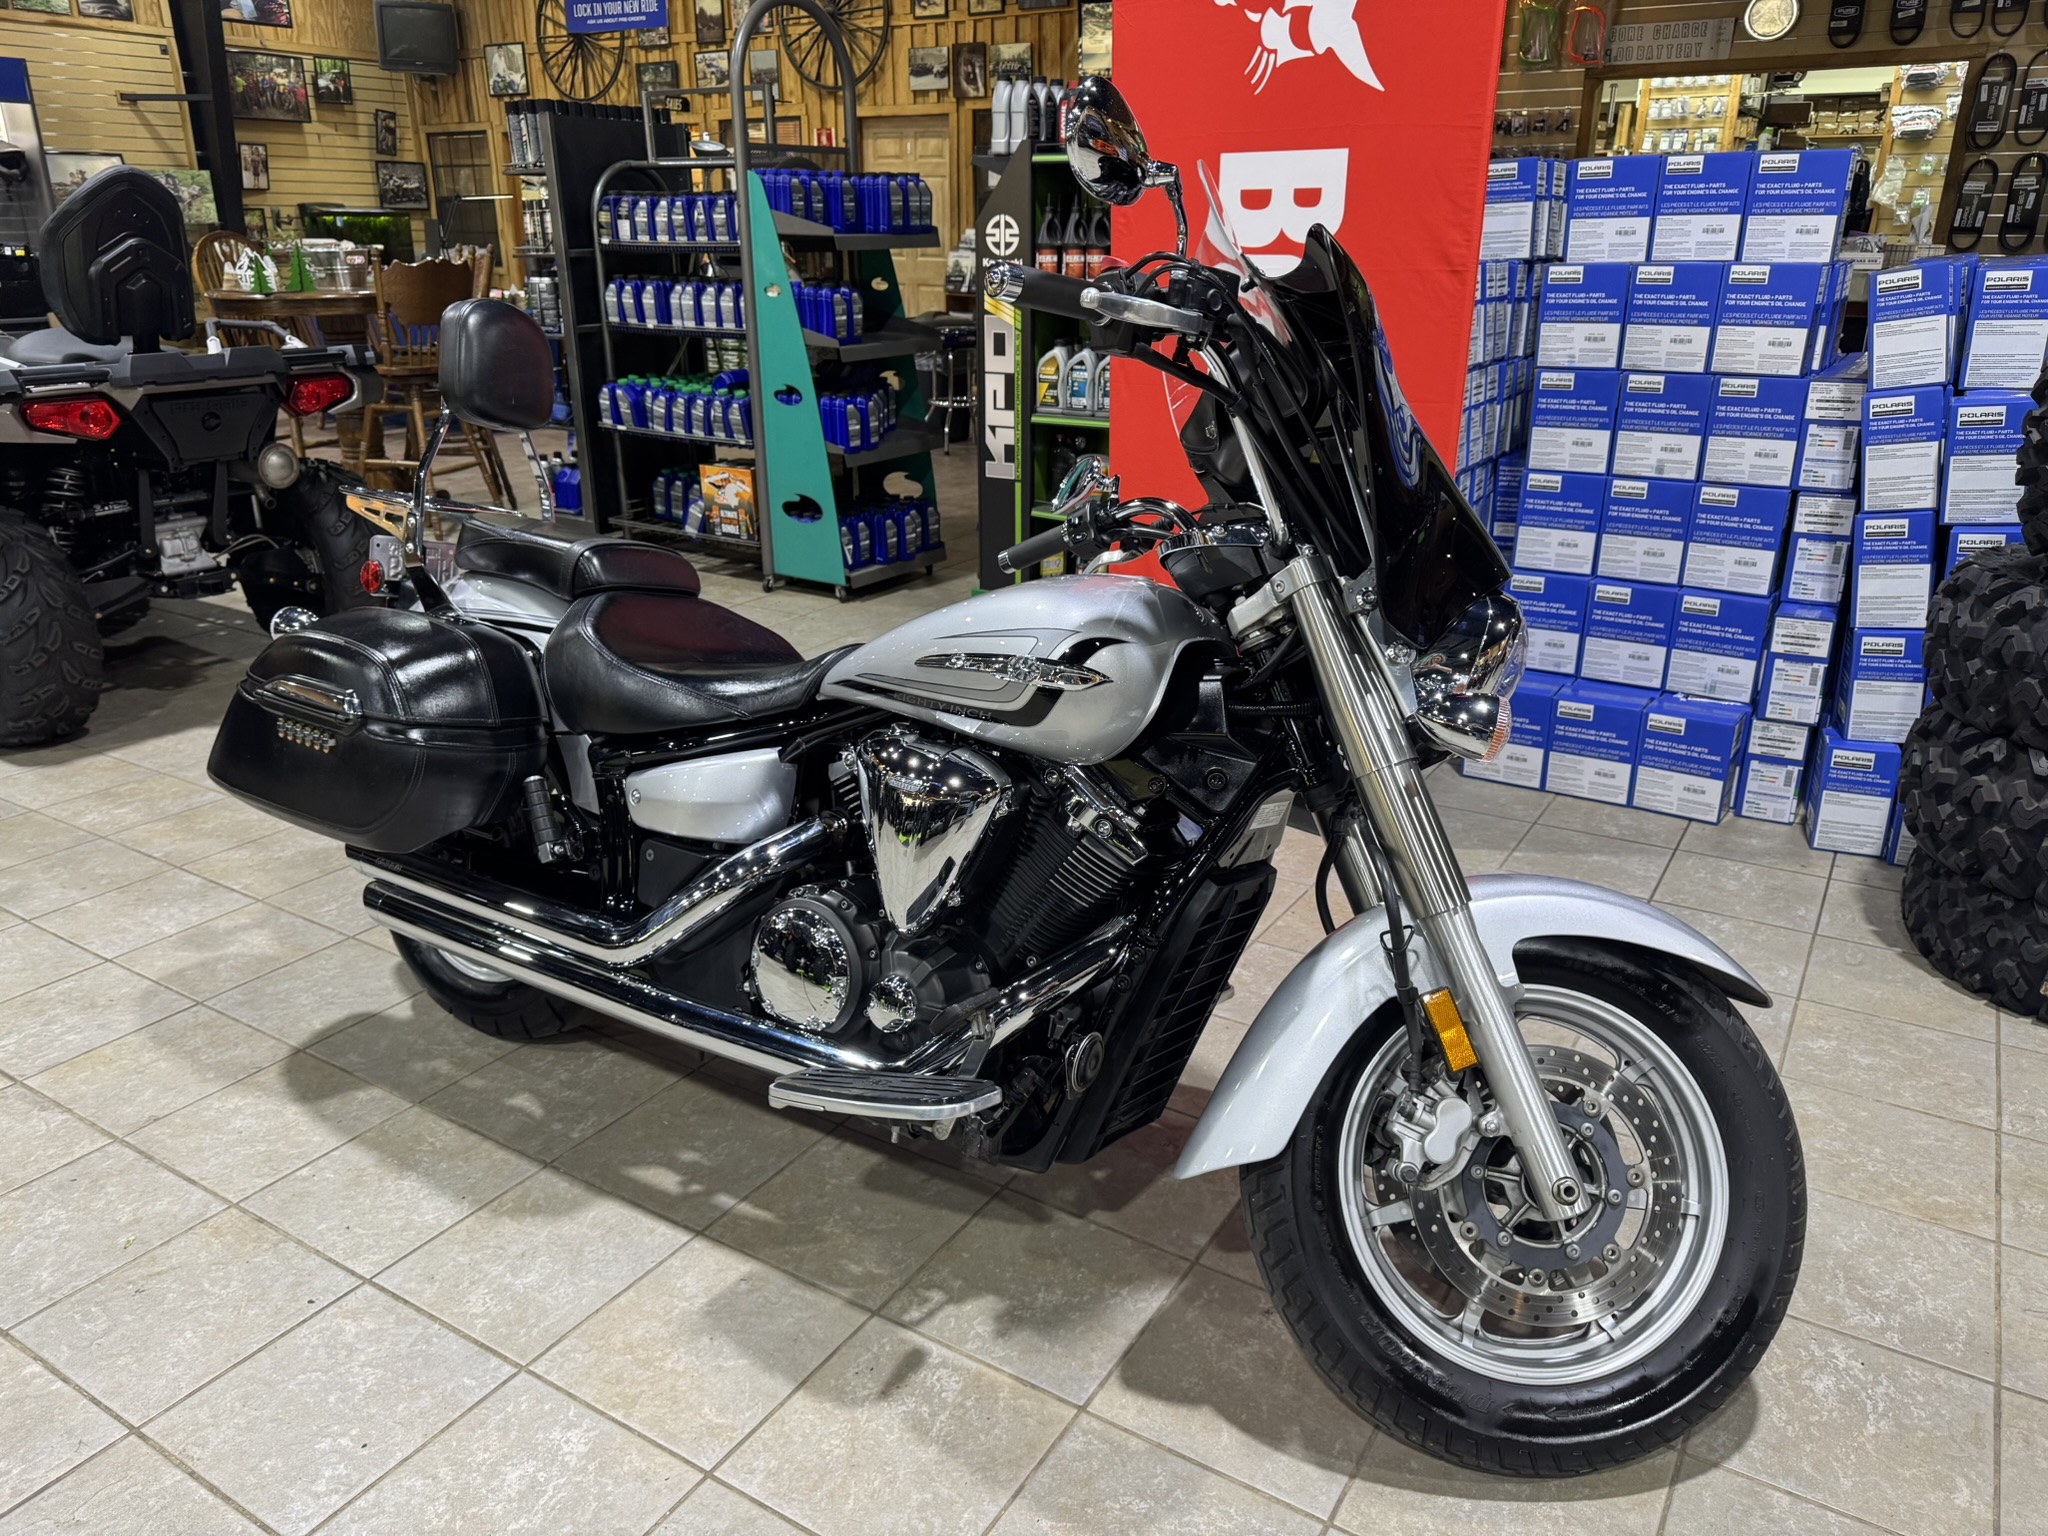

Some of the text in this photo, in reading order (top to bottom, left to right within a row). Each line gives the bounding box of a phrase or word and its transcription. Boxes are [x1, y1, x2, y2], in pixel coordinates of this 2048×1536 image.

[573, 0, 659, 17] LOCK IN YOUR NEW RIDE
[1608, 26, 1644, 42] CORE
[1653, 22, 1708, 40] CHARGE
[1637, 43, 1703, 60] BATTERY
[666, 98, 682, 110] SALES
[1878, 275, 1920, 285] POLARIS
[984, 314, 1015, 480] KPO
[1702, 491, 1737, 499] POLARIS
[1684, 600, 1718, 609] POLARIS
[894, 693, 991, 719] EIGHTY INCH
[1649, 718, 1683, 727] POLARIS
[1834, 754, 1873, 763] POLARIS
